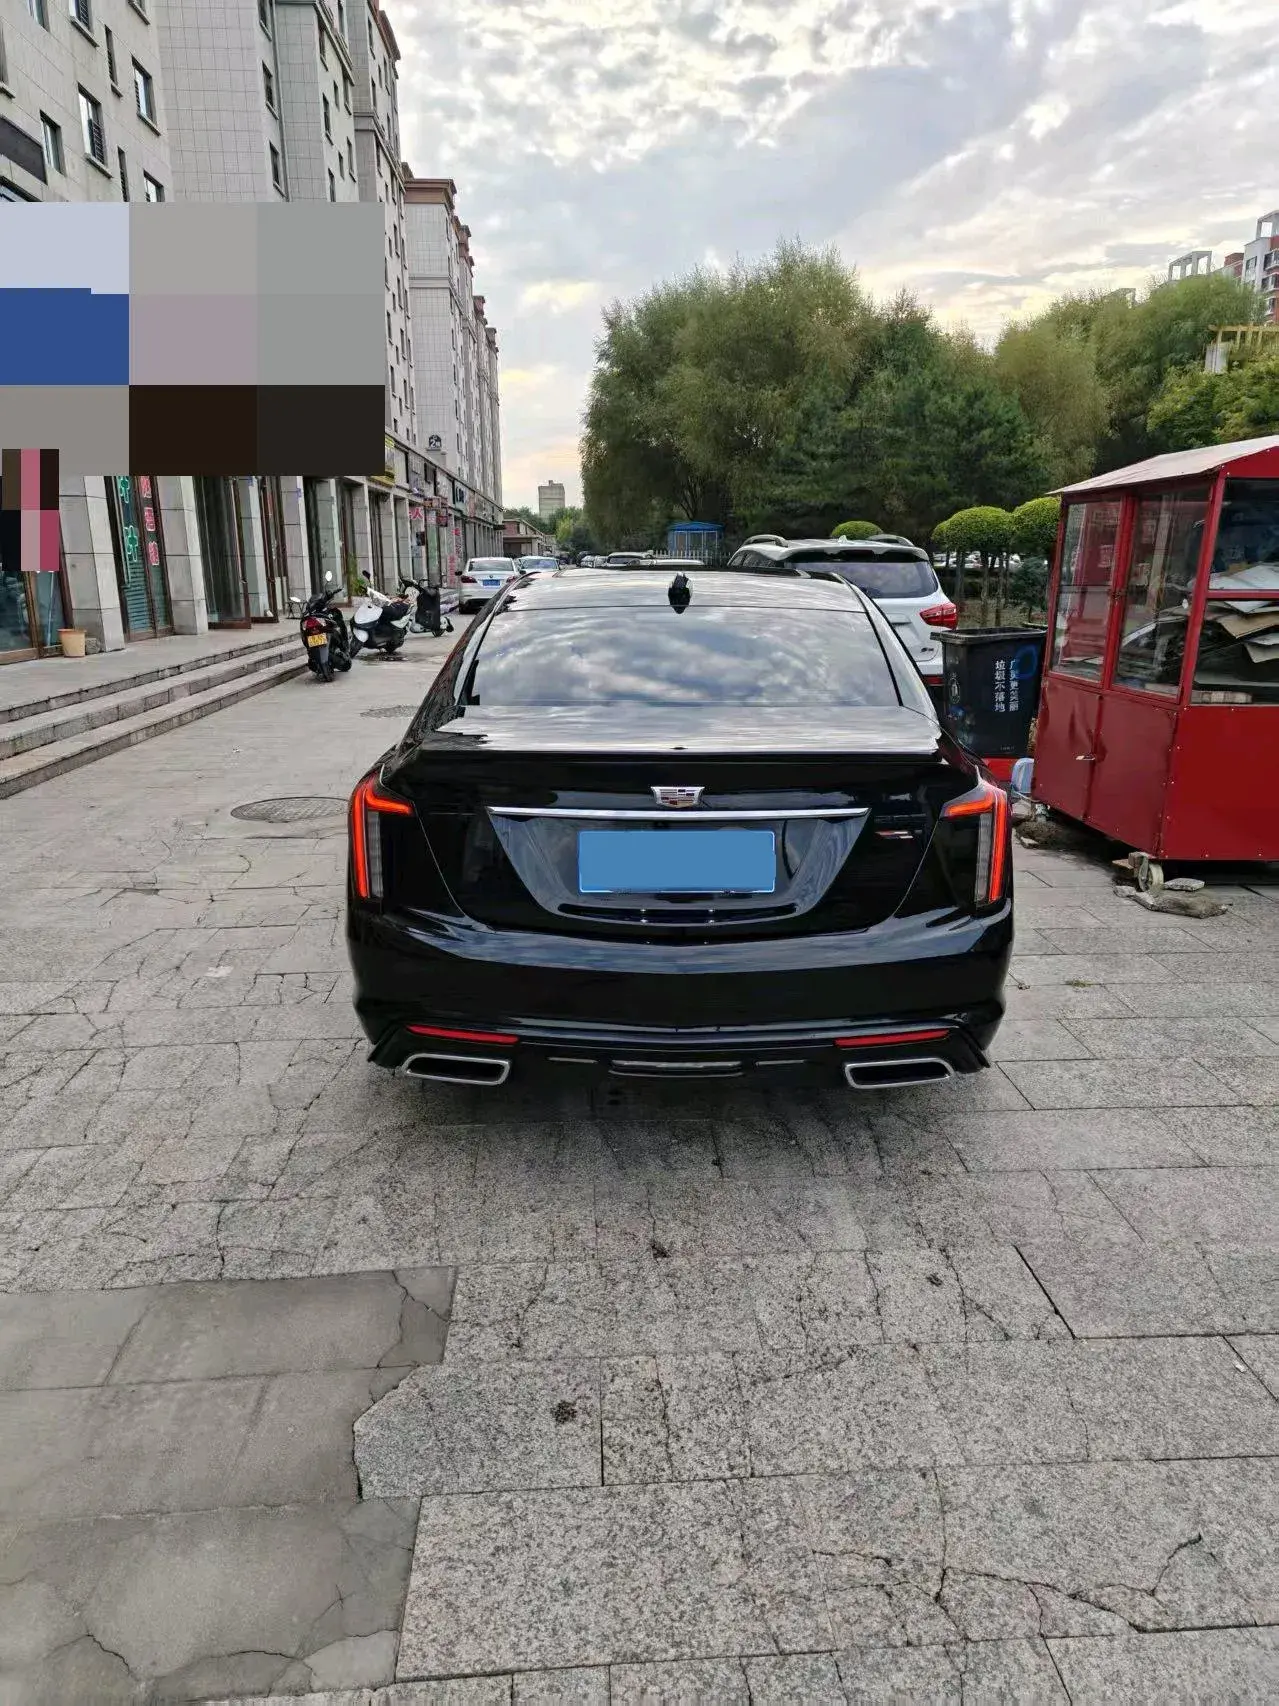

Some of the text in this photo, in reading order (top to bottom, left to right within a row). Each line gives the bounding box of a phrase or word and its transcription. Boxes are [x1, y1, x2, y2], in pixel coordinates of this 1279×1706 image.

[994, 660, 1006, 712] 垃圾不落地
